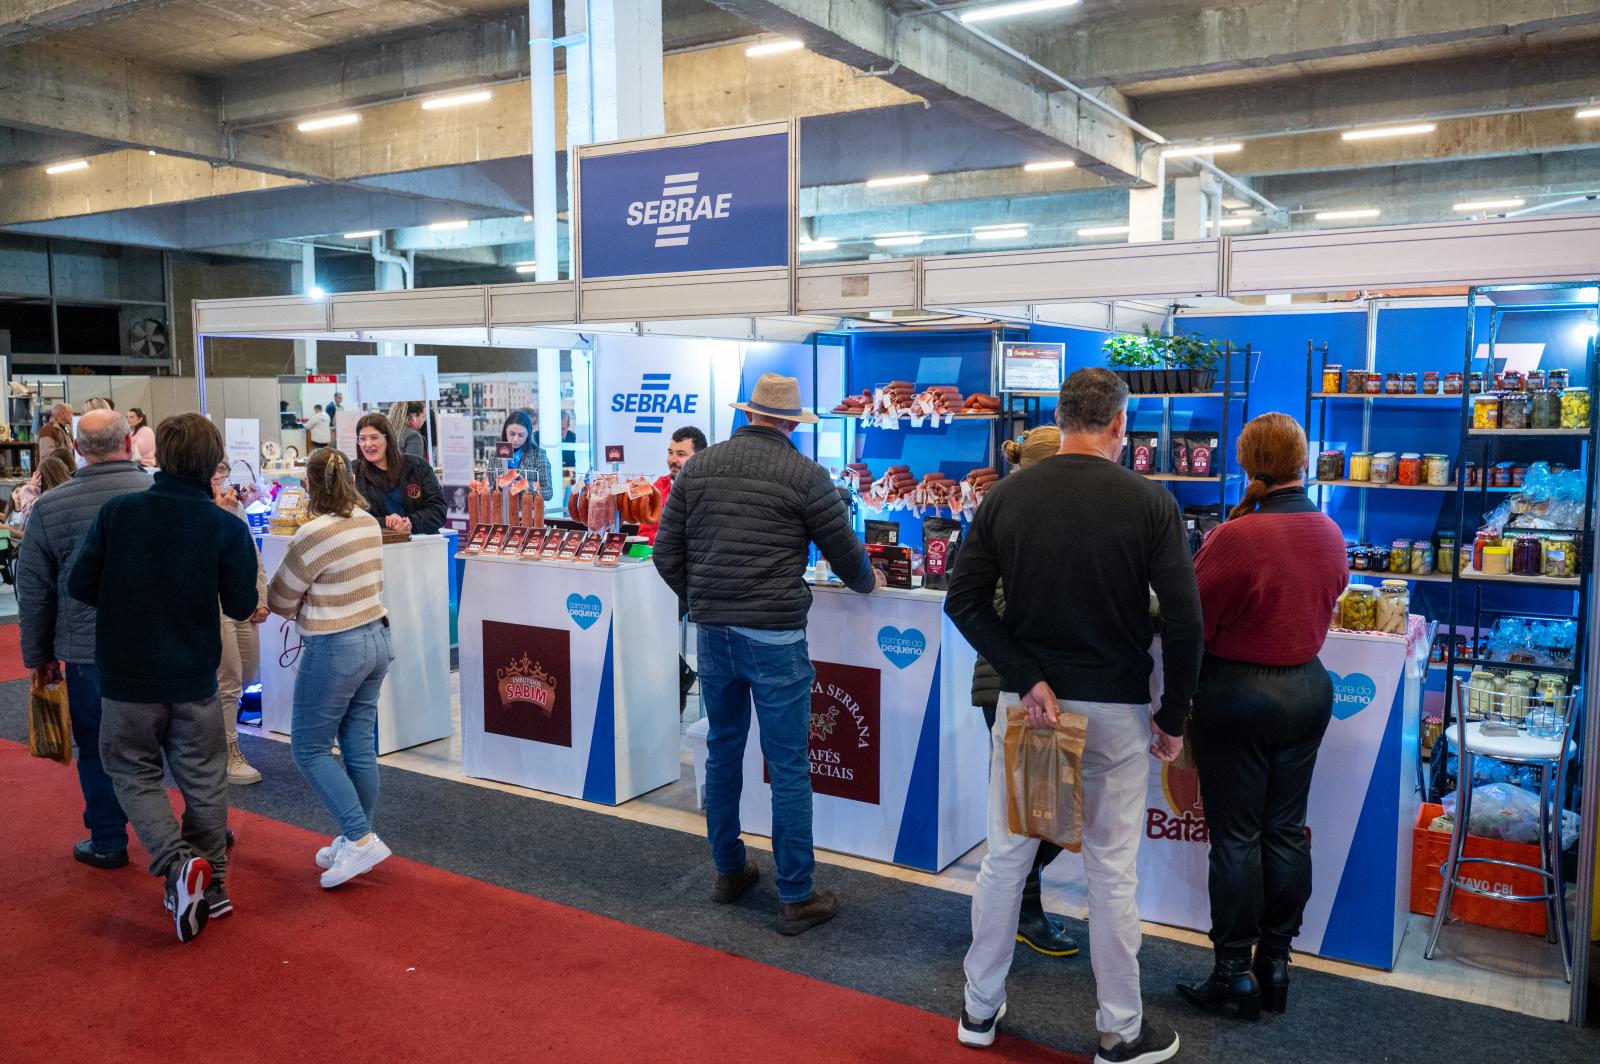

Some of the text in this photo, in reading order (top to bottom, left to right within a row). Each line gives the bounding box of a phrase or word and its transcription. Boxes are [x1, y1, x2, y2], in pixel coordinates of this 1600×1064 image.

[626, 192, 733, 226] SEBRAE
[313, 374, 331, 383] SAÍDA
[610, 393, 699, 414] SEBRAE
[569, 608, 600, 618] pequeno
[880, 636, 923, 648] compre do
[881, 644, 923, 656] pequeno
[505, 683, 548, 706] SABIM
[1356, 681, 1372, 695] do
[826, 683, 870, 749] SERRANA
[807, 748, 841, 764] AFÉS
[809, 761, 854, 780] ECIAIS
